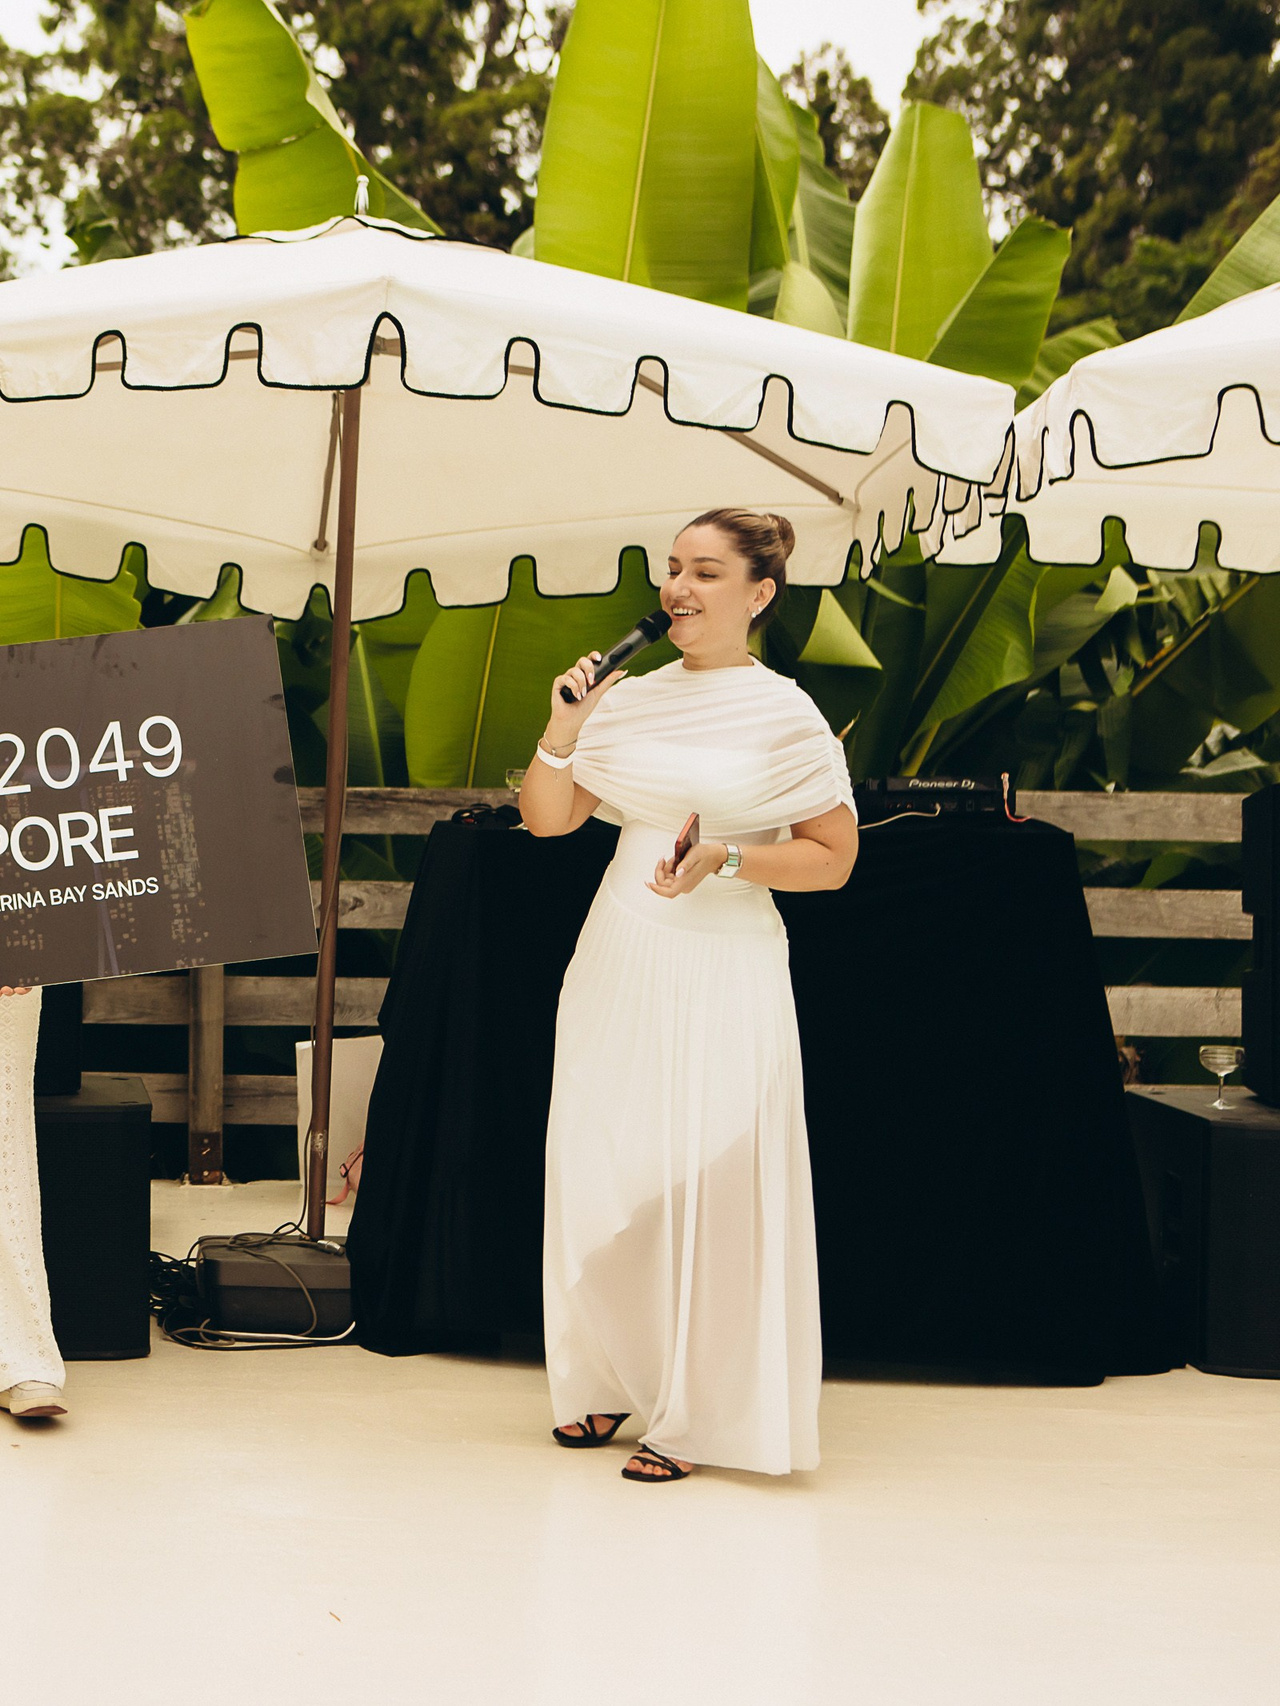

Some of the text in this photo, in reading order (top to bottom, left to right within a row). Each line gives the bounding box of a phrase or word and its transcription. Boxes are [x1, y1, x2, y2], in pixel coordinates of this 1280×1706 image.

[908, 779, 958, 788] Pioneer
[50, 885, 87, 907] BAY
[92, 876, 160, 902] SANDS
